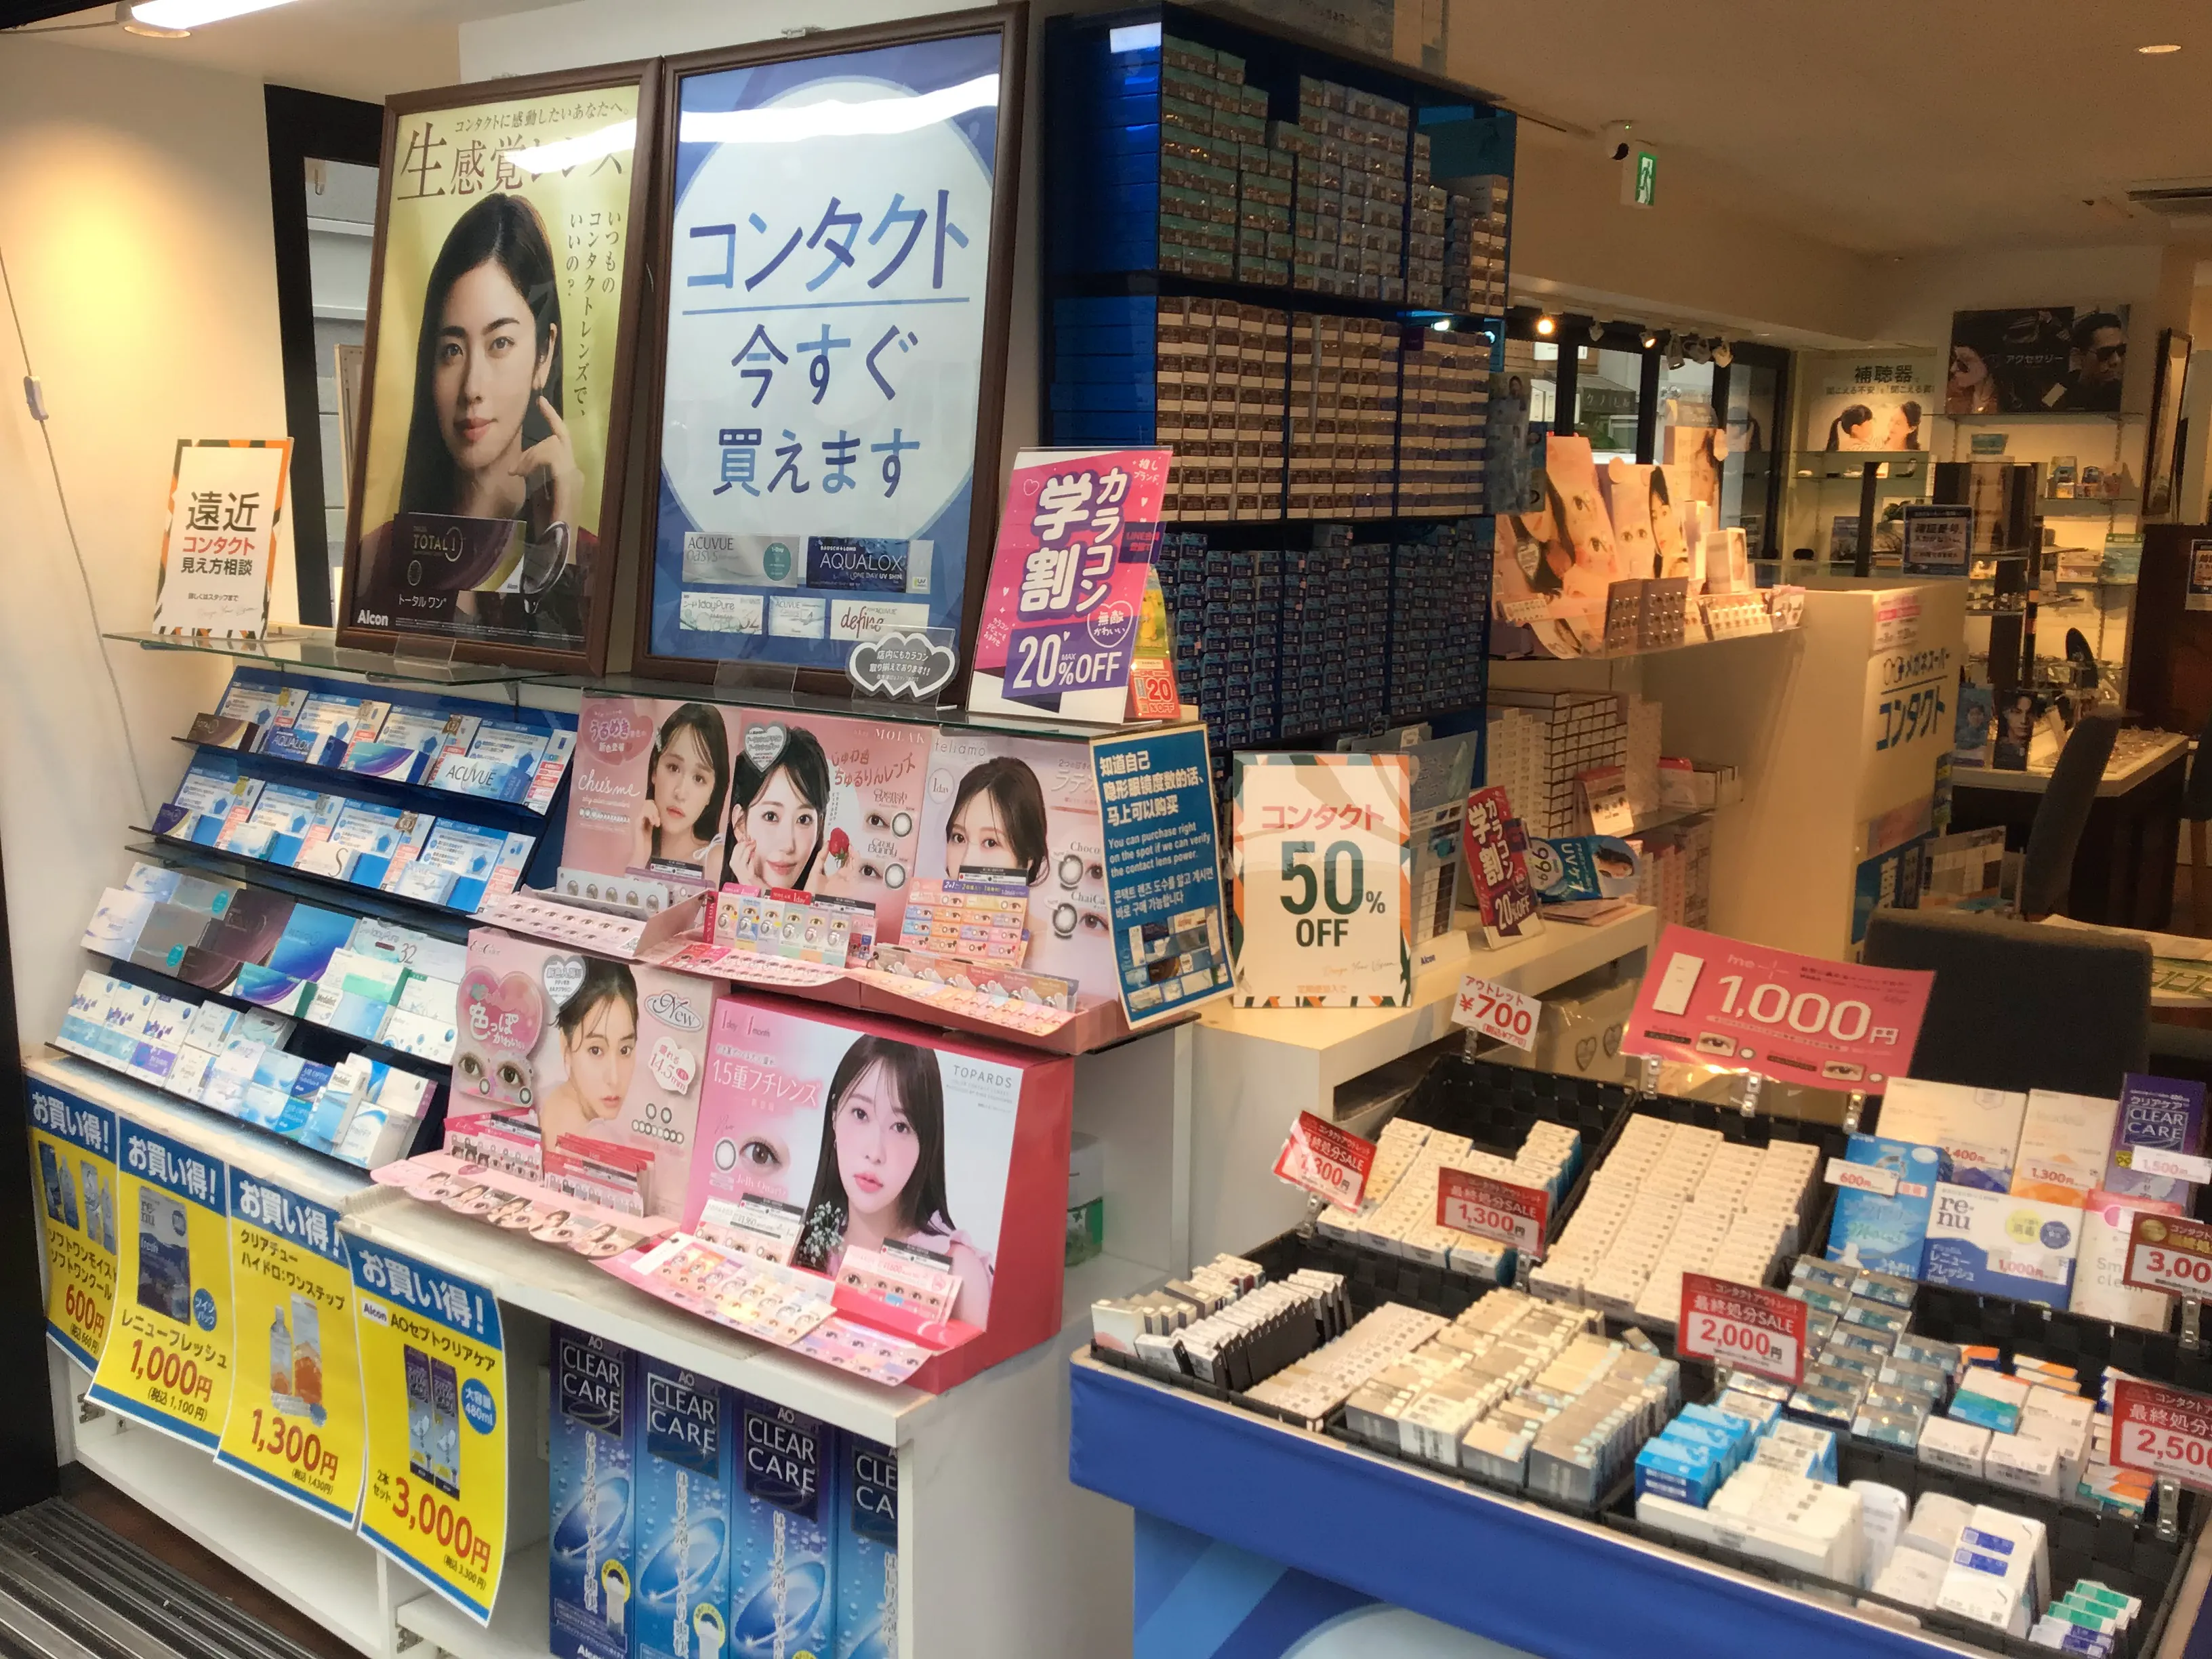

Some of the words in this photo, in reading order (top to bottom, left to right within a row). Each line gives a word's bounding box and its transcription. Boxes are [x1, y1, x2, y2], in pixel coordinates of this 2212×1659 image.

[602, 212, 621, 293] いつもの
[687, 190, 969, 292] コンタクト
[731, 324, 918, 408] 今すぐ
[713, 428, 920, 497] 買えます
[186, 491, 260, 532] 遠近
[182, 536, 255, 556] コンタクト
[413, 534, 447, 550] TOTAL
[689, 537, 734, 550] ACUVUE
[1020, 472, 1092, 612] 学割
[1076, 468, 1127, 612] カラコン
[181, 557, 253, 576] 見え方相談
[819, 553, 902, 571] AQUALOX
[358, 610, 388, 626] Alcon
[841, 606, 884, 638] define
[1098, 611, 1124, 626] 無敵
[877, 650, 928, 661] 店内にもカラコン
[1147, 678, 1172, 702] 20
[590, 718, 630, 742] うるめき
[1877, 685, 1945, 751] コンタクト
[935, 737, 986, 756] teliamo
[1099, 750, 1151, 777] 知道自己
[445, 764, 496, 786] ACUVUE
[835, 752, 915, 787] ちゅるりんレンズ
[1107, 795, 1179, 827] 马上可以购买
[1262, 804, 1385, 831] コンタクト
[1108, 838, 1124, 848] You
[1126, 835, 1139, 845] can
[1141, 827, 1176, 844] purchase
[1178, 822, 1196, 835] right
[1109, 855, 1120, 863] on
[1122, 851, 1134, 861] the
[1136, 846, 1153, 858] spot
[1155, 842, 1160, 853] if
[1162, 842, 1172, 851] we
[1174, 839, 1188, 848] can
[1190, 832, 1210, 845] verify
[1469, 802, 1504, 886] 学割
[1486, 798, 1513, 879] カラコン
[1111, 867, 1124, 878] the
[1126, 861, 1153, 874] contact
[1155, 857, 1171, 866] lens
[1296, 918, 1349, 947] OFF
[1466, 975, 1523, 1006] アウトレット
[653, 994, 695, 1026] New
[1459, 993, 1532, 1036] ¥700
[1718, 975, 1899, 1045] 1,000円
[713, 1059, 821, 1107] 1.5重フチレンズ
[954, 1065, 1012, 1088] TOPARDS
[33, 1091, 109, 1153] お買い得!
[2128, 1122, 2182, 1139] CARE
[2130, 1109, 2184, 1126] CLEAR
[128, 1136, 216, 1204] お買い得!
[240, 1180, 340, 1257] お買い得!
[1458, 1204, 1525, 1236] 1,300円
[360, 1250, 484, 1334] お買い得!
[66, 1284, 105, 1337] 600円
[363, 1301, 387, 1323] Alcon
[1695, 1294, 1793, 1332] 最終処分SALE
[121, 1309, 227, 1368] レニューフレッシュ
[390, 1316, 495, 1372] AOセプトクリアケア
[588, 1336, 603, 1351] AO
[1700, 1319, 1782, 1359] 2,000円
[130, 1339, 213, 1403] 1,000円
[563, 1347, 620, 1387] CLEAR
[678, 1371, 695, 1387] AO
[563, 1374, 621, 1414] CARE
[651, 1382, 715, 1424] CLEAR
[651, 1410, 716, 1452] CARE
[777, 1407, 794, 1424] AO
[2129, 1404, 2212, 1437] 最終処分
[251, 1408, 338, 1481] 1,300円
[747, 1418, 815, 1464] CLEAR
[747, 1447, 816, 1493] CARE
[392, 1477, 491, 1574] 3,000円
